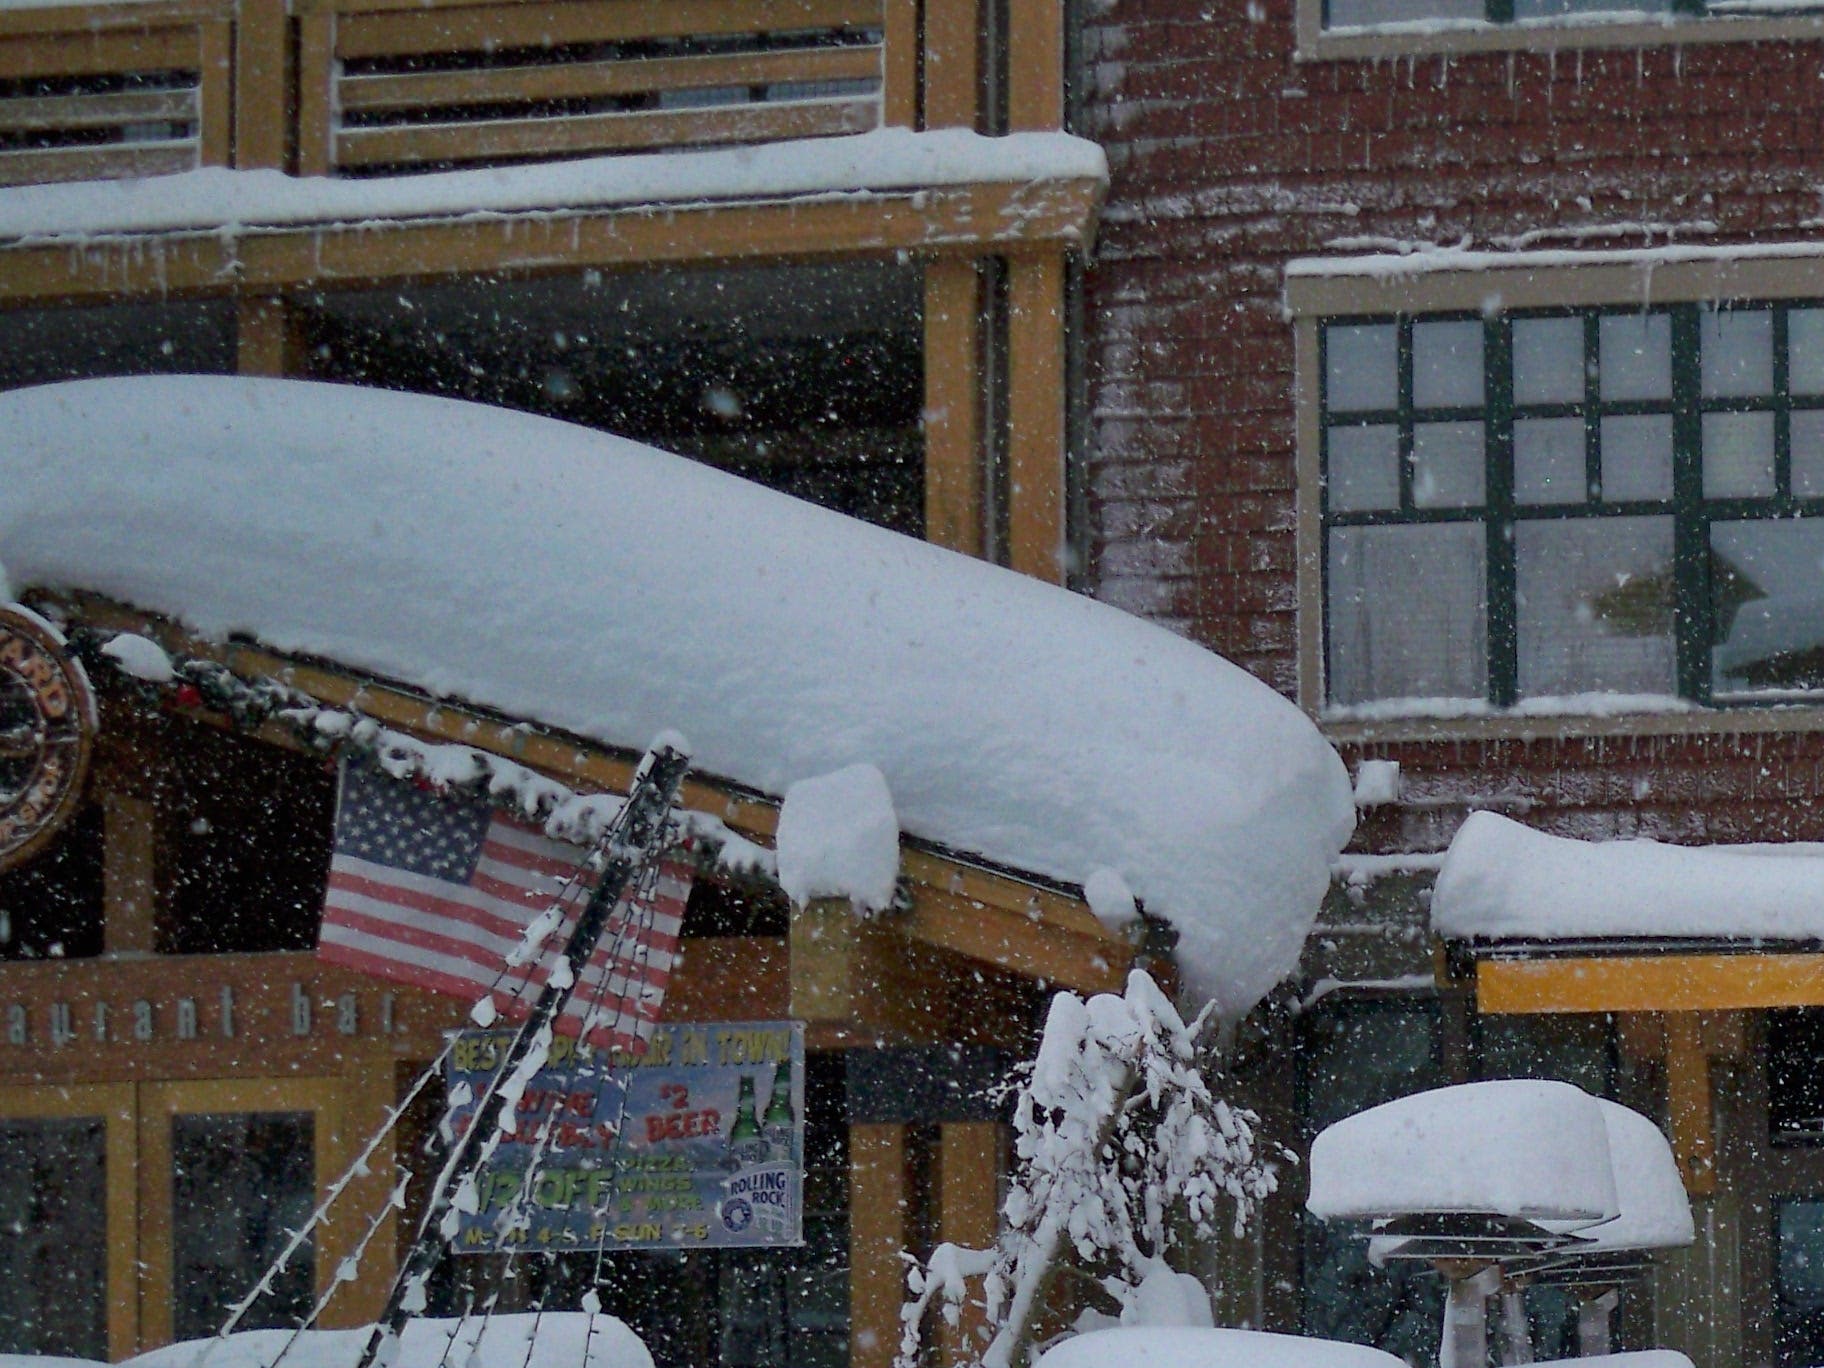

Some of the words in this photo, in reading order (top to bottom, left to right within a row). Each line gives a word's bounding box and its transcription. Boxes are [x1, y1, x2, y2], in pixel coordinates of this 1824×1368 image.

[293, 982, 395, 1035] bar
[645, 1106, 722, 1143] BEER
[534, 1168, 613, 1209] OFF
[731, 1171, 786, 1195] ROLLING
[752, 1190, 786, 1208] ROCK
